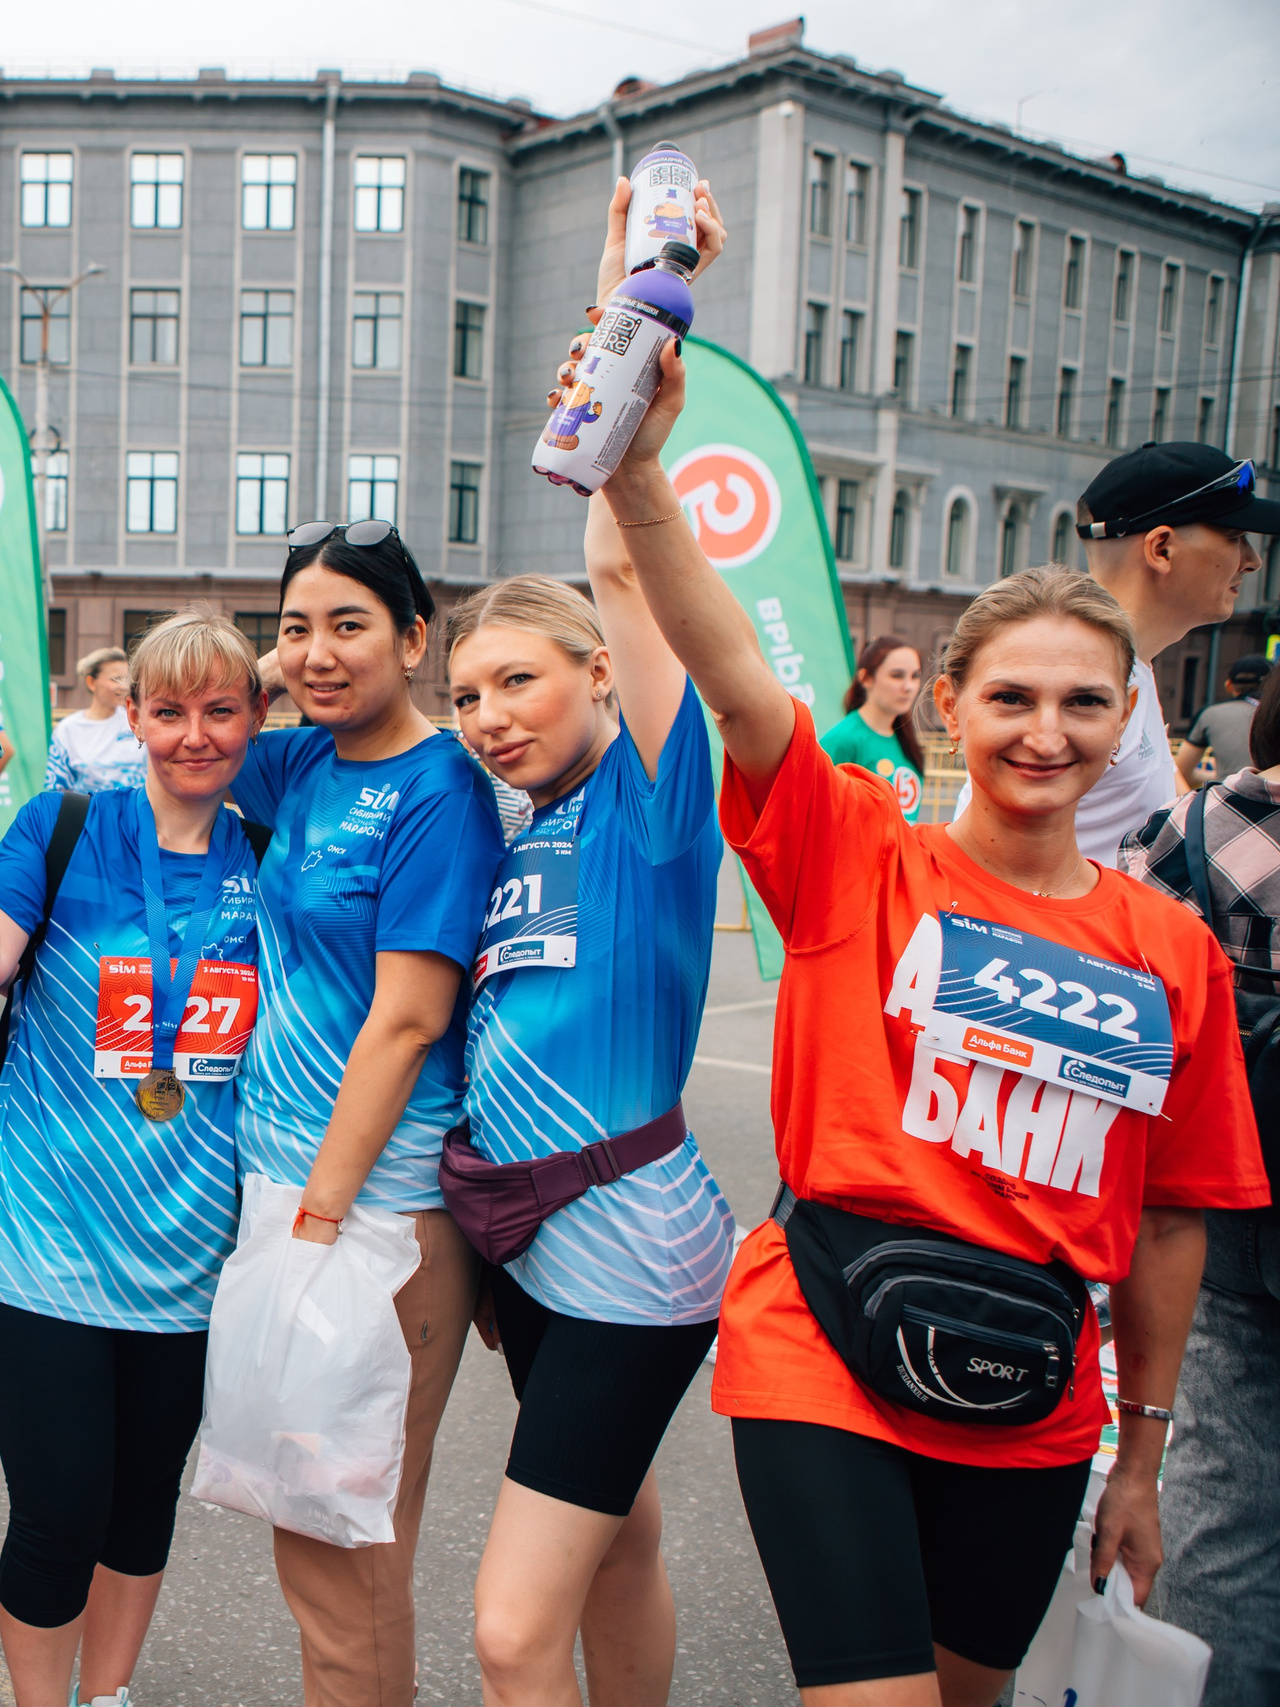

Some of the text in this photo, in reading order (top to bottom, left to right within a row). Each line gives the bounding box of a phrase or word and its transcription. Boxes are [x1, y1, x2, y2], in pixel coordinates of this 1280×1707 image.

[517, 842, 550, 853] АВГУСТА
[483, 874, 542, 933] 221
[209, 967, 239, 975] АВГУСТА
[1078, 955, 1155, 985] 3 АВГУСТА 2024
[974, 957, 1140, 1043] 4222
[122, 994, 241, 1034] 227
[969, 1034, 1028, 1059] Альфа Банк
[124, 1060, 146, 1070] Альфа
[1070, 1067, 1126, 1092] Следопыт
[901, 1030, 1123, 1198] БАНК
[966, 1357, 1029, 1383] SPORT
